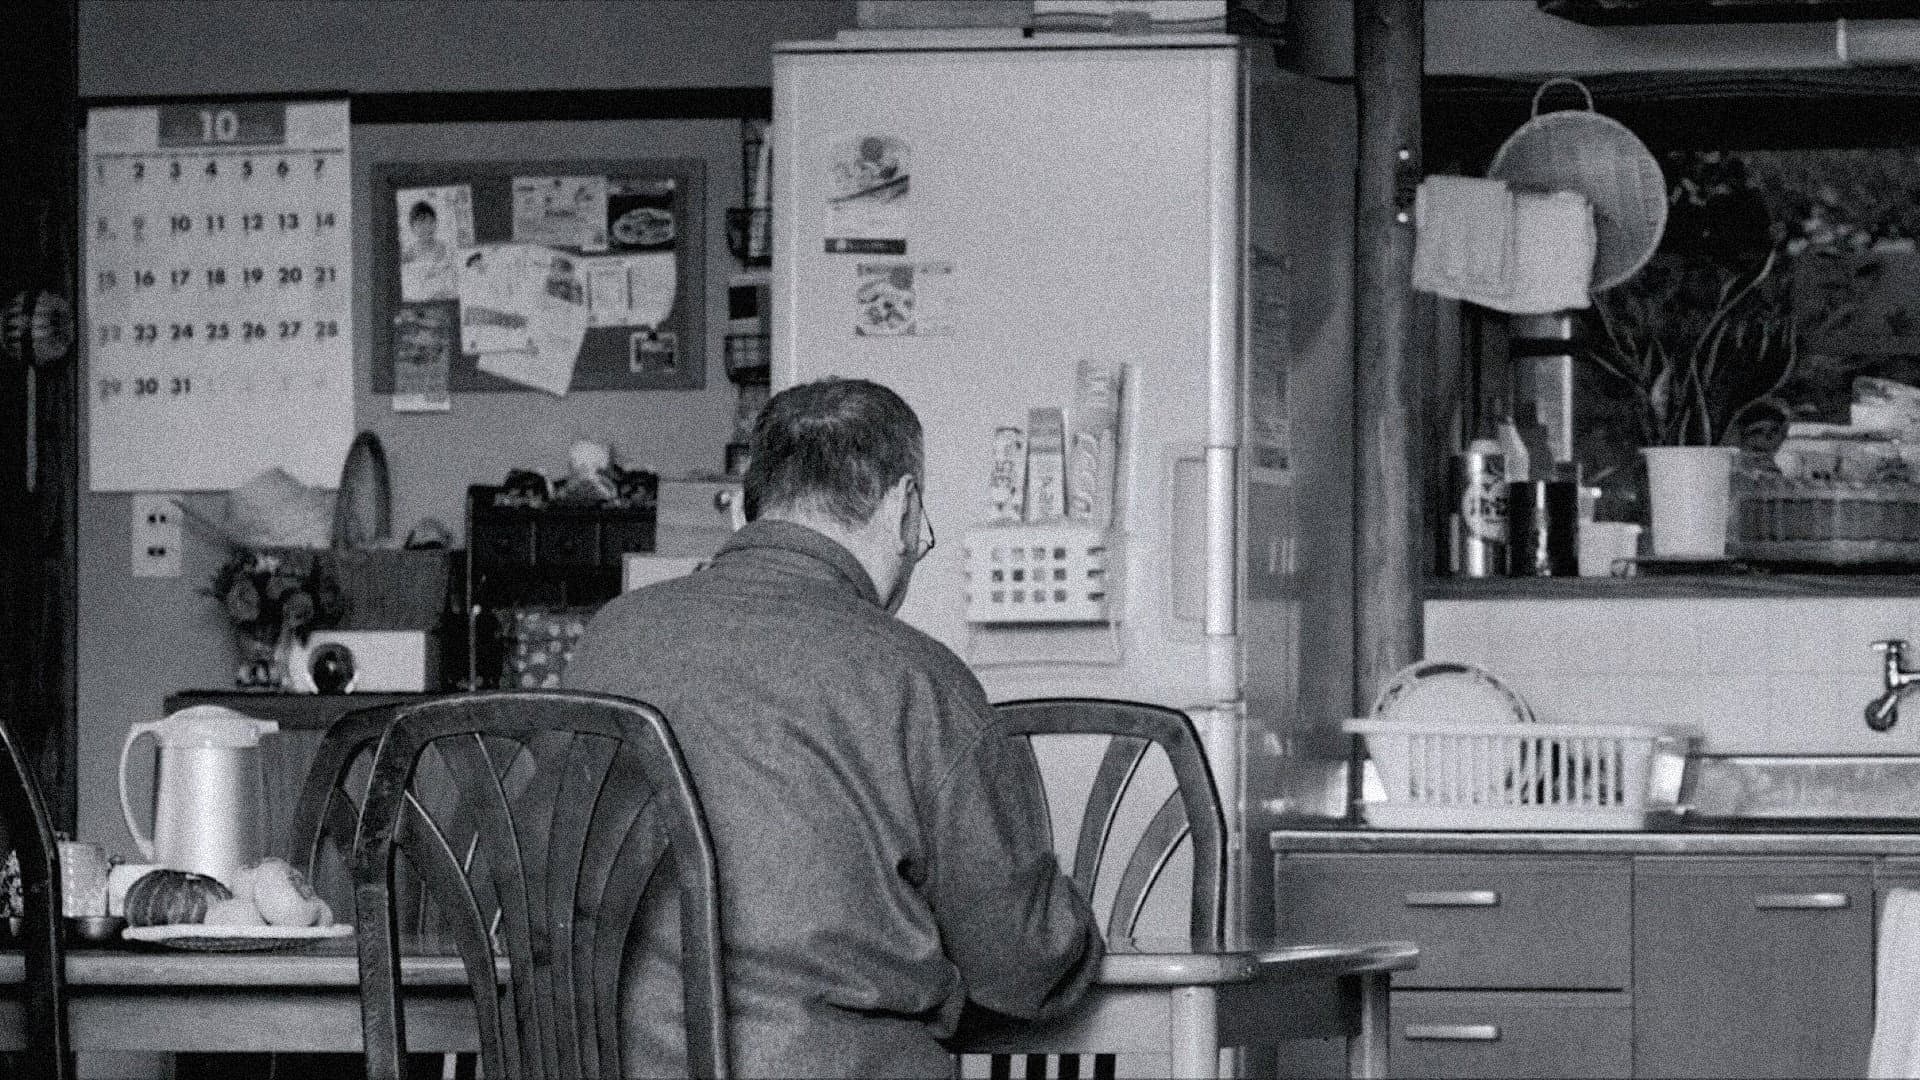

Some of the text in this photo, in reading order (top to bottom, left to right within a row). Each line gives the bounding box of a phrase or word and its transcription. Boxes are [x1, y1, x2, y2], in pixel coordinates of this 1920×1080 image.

[200, 109, 239, 141] 10
[133, 161, 145, 179] 2
[170, 161, 182, 179] 3
[205, 160, 218, 176] 4
[242, 159, 253, 177] 5
[276, 159, 289, 177] 6
[313, 158, 325, 173] 7
[170, 214, 192, 232] 10
[205, 214, 226, 231] 11
[242, 213, 264, 231] 12
[278, 212, 299, 230] 13
[315, 212, 336, 229] 14
[133, 269, 156, 287] 16
[170, 268, 191, 286] 17
[205, 268, 226, 286] 18
[242, 267, 264, 284] 19
[278, 266, 303, 284] 20
[314, 265, 337, 284] 21
[133, 323, 158, 343] 23
[170, 323, 194, 341] 24
[205, 321, 230, 340] 25
[242, 321, 267, 340] 26
[278, 320, 303, 339] 27
[314, 319, 339, 338] 28
[133, 376, 159, 396] 30
[170, 376, 192, 395] 31
